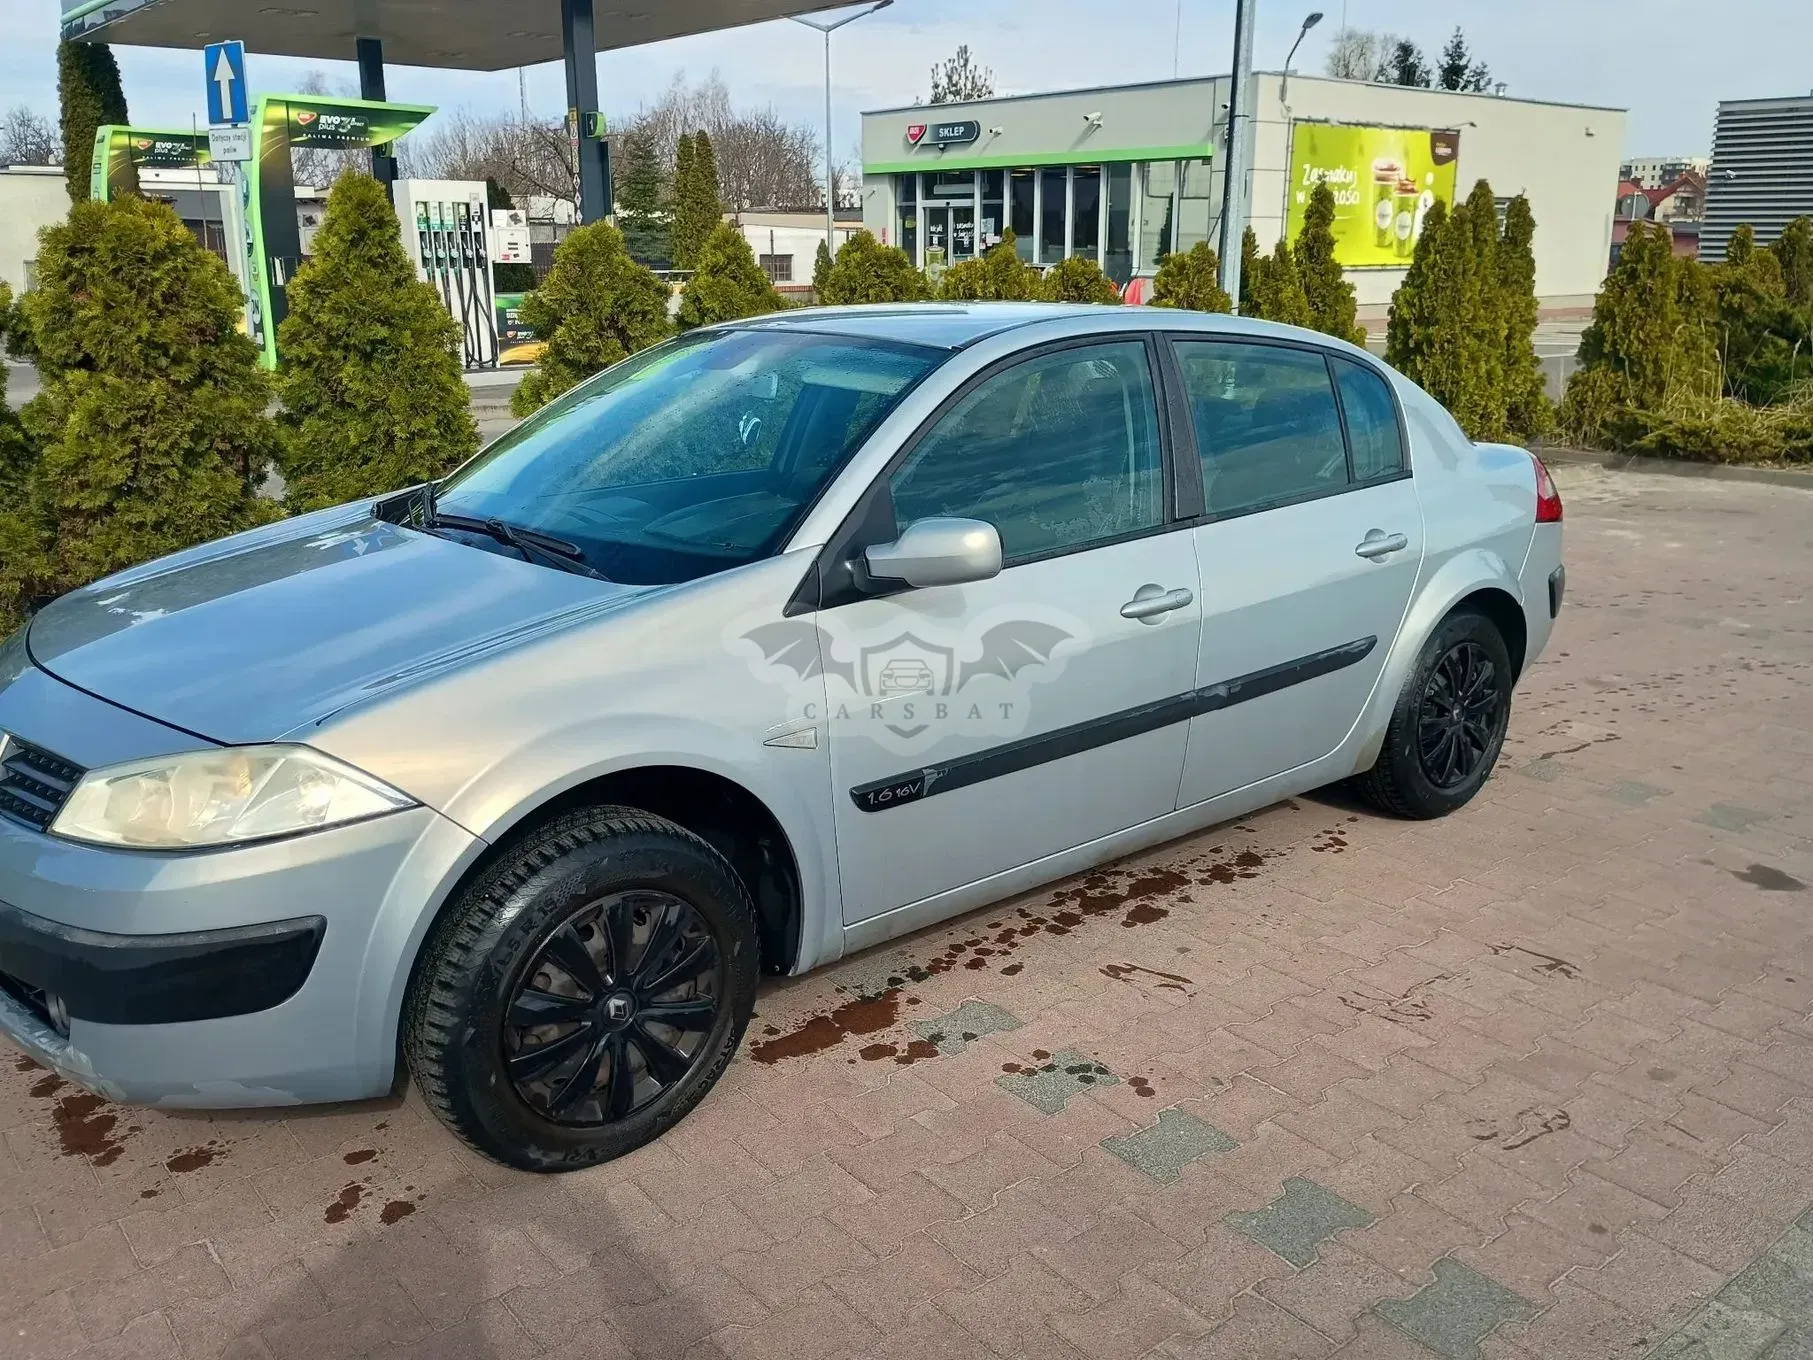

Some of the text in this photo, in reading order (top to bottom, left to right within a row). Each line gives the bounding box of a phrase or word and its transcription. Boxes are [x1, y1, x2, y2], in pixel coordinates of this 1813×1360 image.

[320, 115, 340, 125] EVO
[939, 126, 964, 137] SKLEP
[868, 782, 921, 804] 1.6 16V
